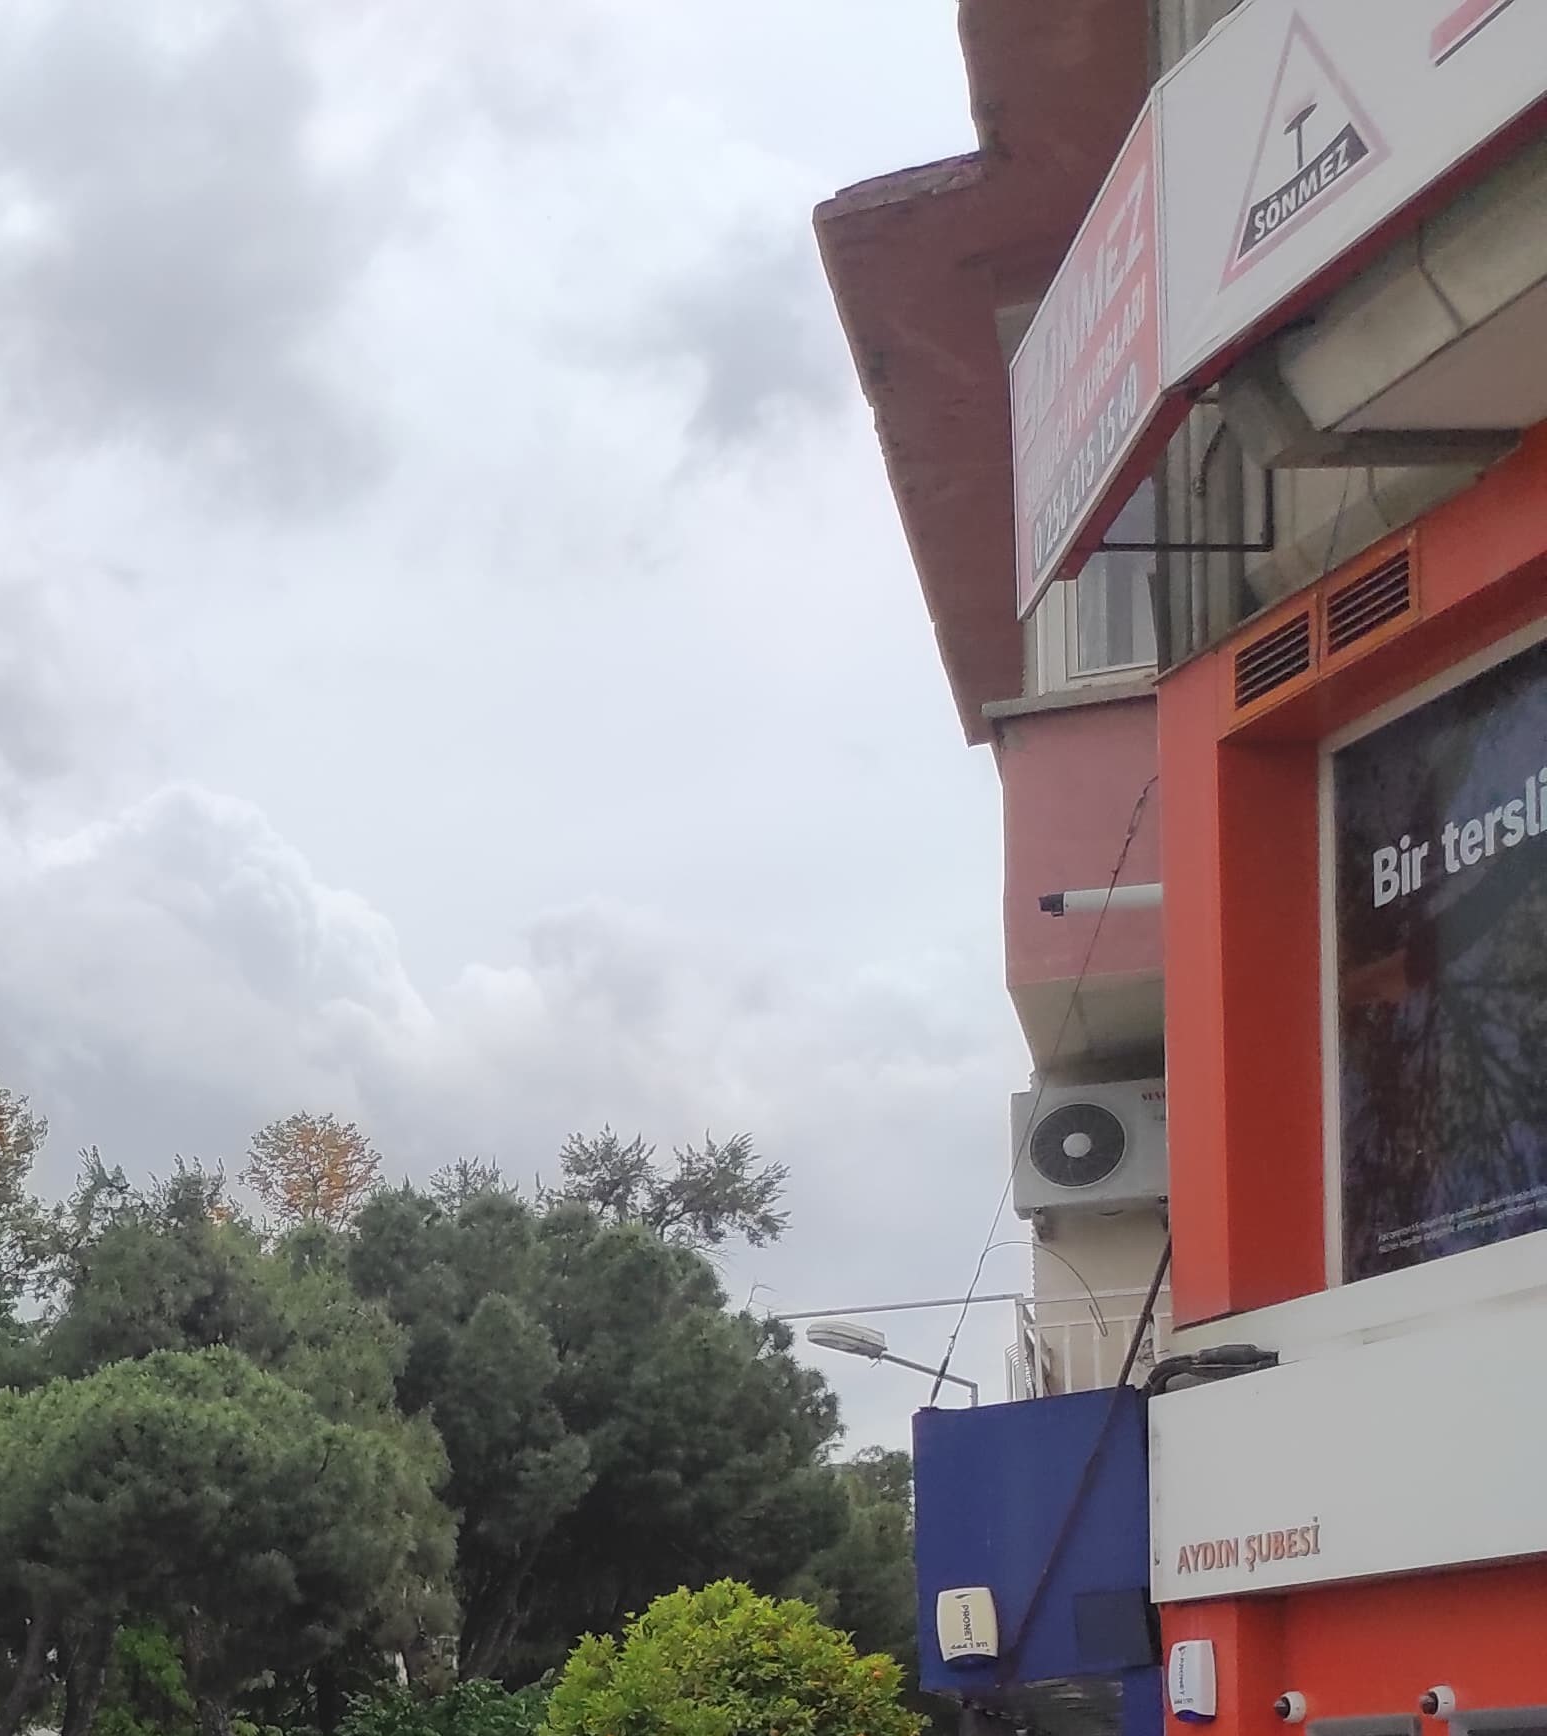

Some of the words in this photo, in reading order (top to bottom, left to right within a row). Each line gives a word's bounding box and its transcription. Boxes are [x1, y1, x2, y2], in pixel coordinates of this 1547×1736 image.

[1254, 138, 1350, 240] SÖNMEZ
[1373, 834, 1430, 908] Bir
[1177, 1545, 1239, 1575] AYDIN
[1244, 1516, 1321, 1572] ŞUBESİ
